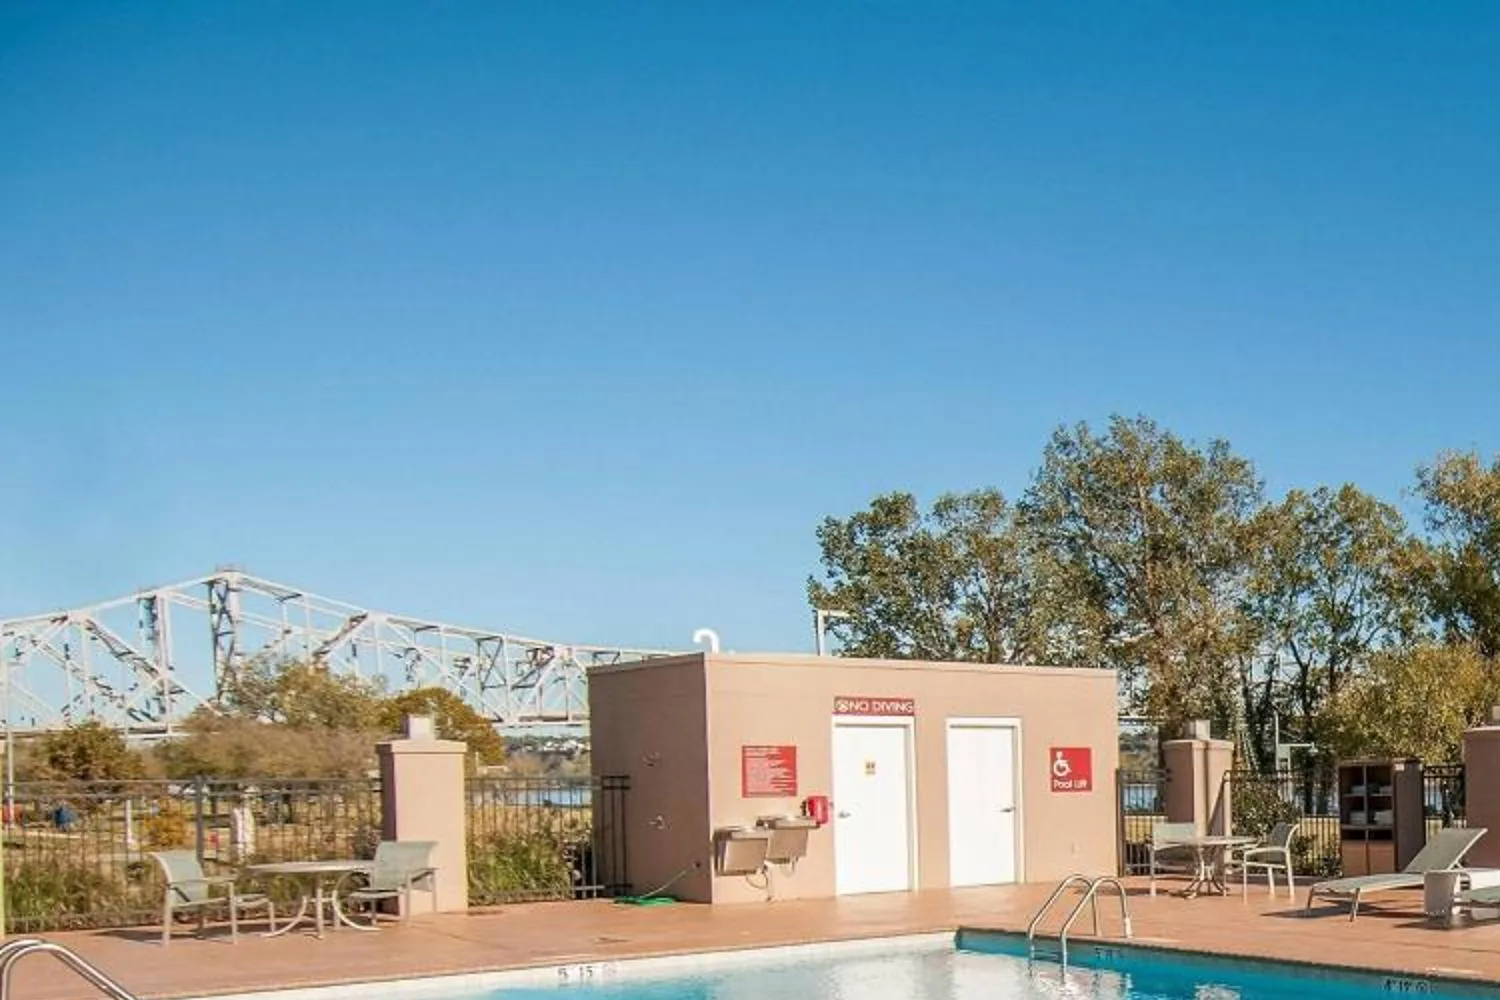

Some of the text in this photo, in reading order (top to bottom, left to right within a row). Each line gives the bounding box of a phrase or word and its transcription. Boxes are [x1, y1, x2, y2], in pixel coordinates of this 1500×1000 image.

[849, 700, 913, 713] NO DIVING
[1053, 779, 1073, 789] Pool
